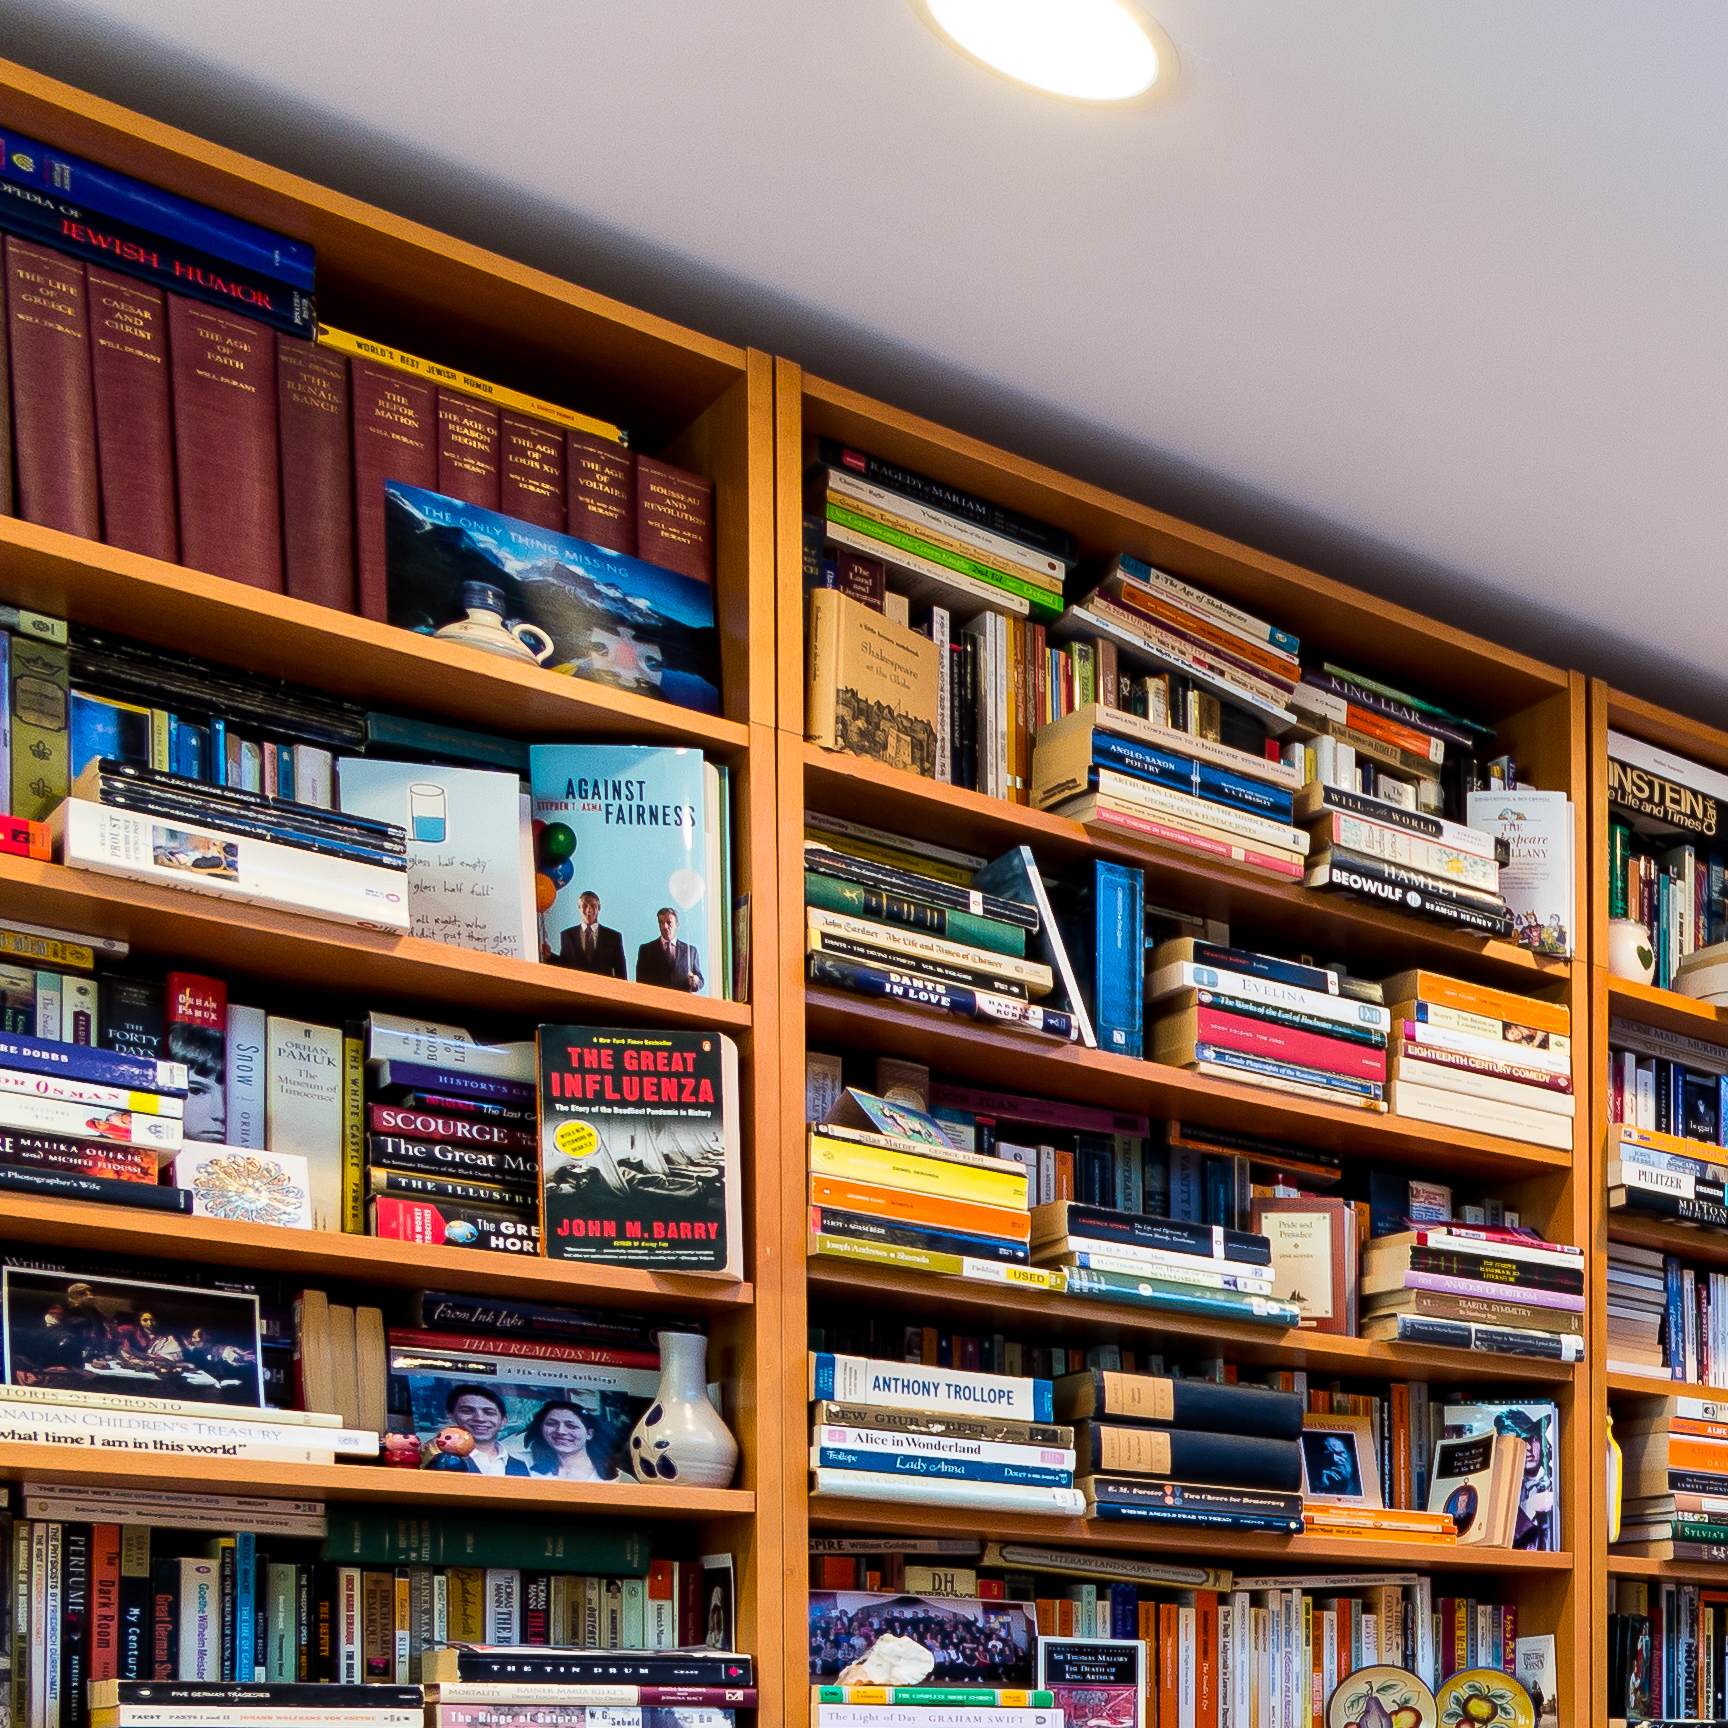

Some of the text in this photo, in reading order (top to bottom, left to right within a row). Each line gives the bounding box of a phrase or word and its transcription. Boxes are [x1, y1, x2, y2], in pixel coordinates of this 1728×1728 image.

[64, 220, 274, 310] JEWISH HUMOR
[355, 341, 394, 360] WORLD'S
[426, 362, 458, 384] JEWISH
[461, 374, 494, 395] HUMOR
[424, 505, 629, 580] THE ONLY THING MISSING
[1331, 677, 1422, 723] KING LEAR
[565, 778, 646, 801] AGAINST
[605, 804, 696, 828] FAIRNESS
[1332, 868, 1403, 902] BEOWULF
[885, 984, 951, 1008] IN LOVE
[890, 973, 946, 994] DANTE
[570, 1047, 697, 1072] THE GREAT
[551, 1073, 714, 1102] INFLUENZA
[382, 1111, 508, 1144] SCOURGE
[384, 1139, 498, 1169] The Great
[1637, 1169, 1683, 1189] PULITZER
[559, 1219, 719, 1241] JOHN M. BARRY
[1012, 1268, 1044, 1285] USED
[872, 1375, 1014, 1405] ANTHONY TROLLOPE
[852, 1432, 982, 1456] Alice in Wonderland
